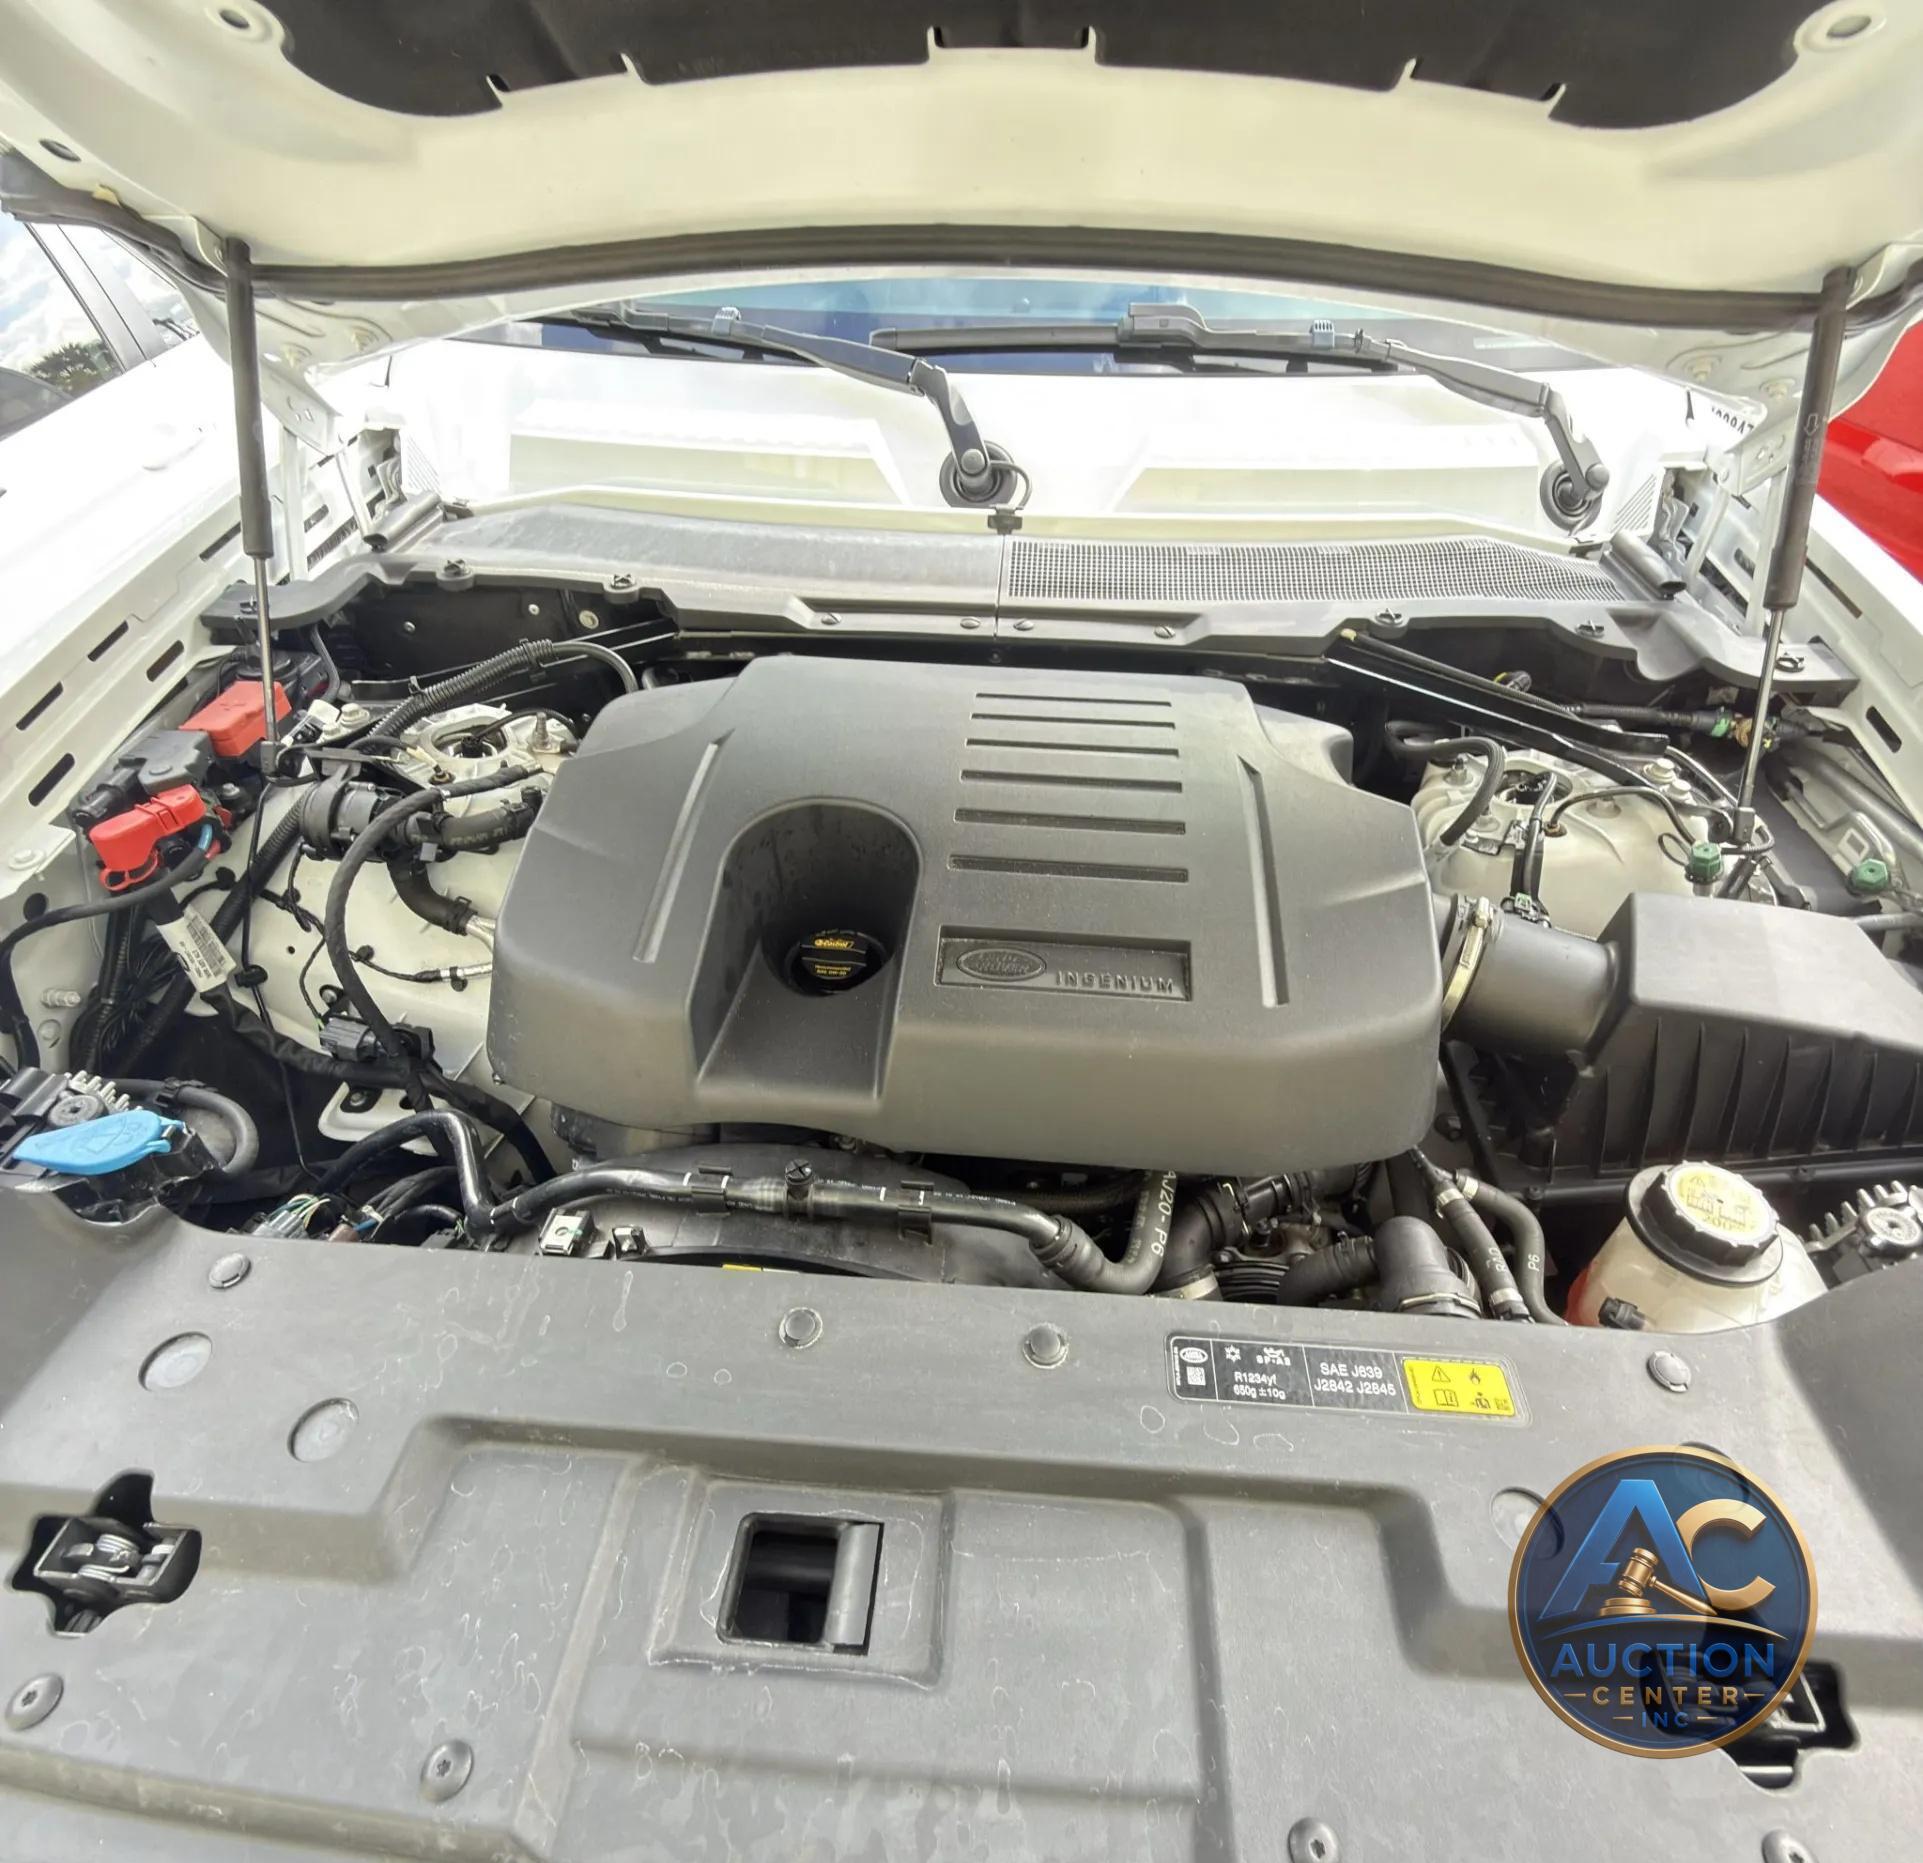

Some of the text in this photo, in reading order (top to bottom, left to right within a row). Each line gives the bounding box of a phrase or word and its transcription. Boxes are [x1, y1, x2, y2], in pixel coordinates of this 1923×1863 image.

[1055, 970, 1174, 994] INGENIUM
[1527, 1252, 1540, 1272] P6
[1319, 1362, 1384, 1380] SAE J639
[1233, 1384, 1257, 1399] 650g
[1314, 1378, 1354, 1394] J2842
[1356, 1381, 1396, 1397] J2845
